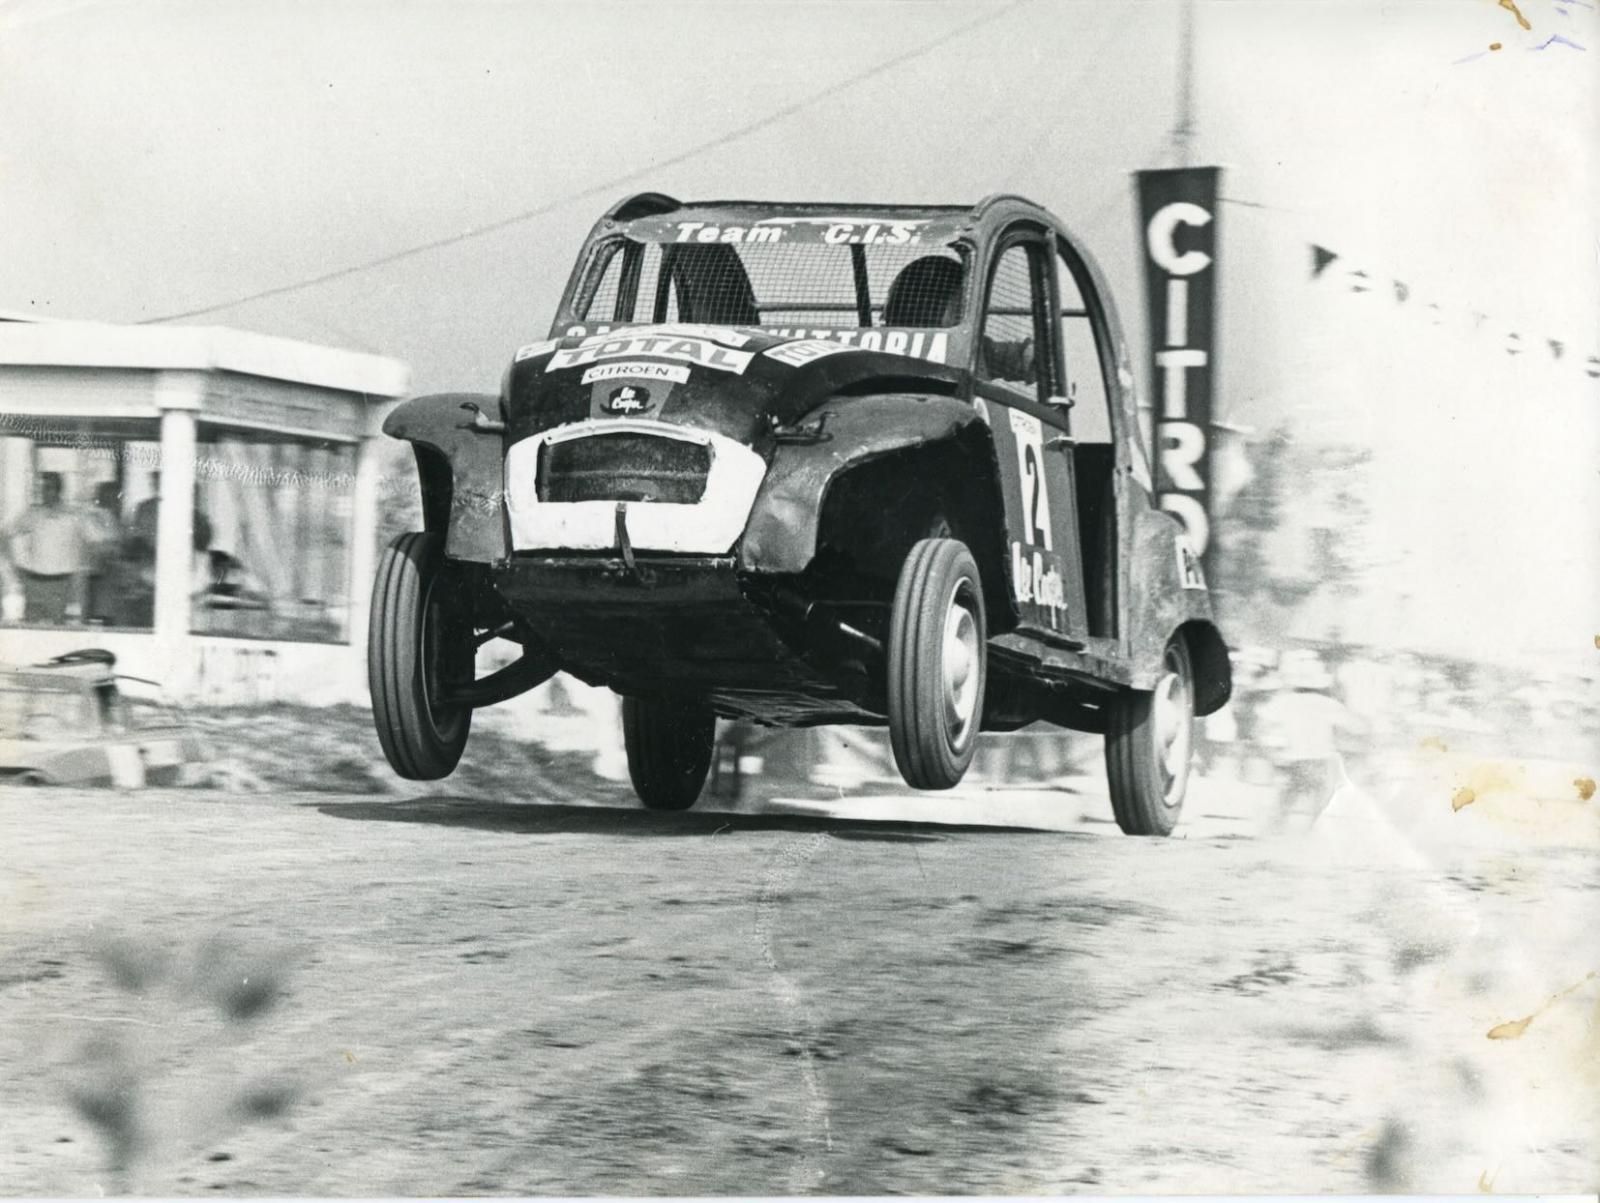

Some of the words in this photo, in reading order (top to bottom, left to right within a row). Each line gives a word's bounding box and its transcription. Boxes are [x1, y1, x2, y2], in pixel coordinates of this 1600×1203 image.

[675, 221, 783, 243] Team
[823, 221, 921, 244] C.I.S.
[560, 336, 740, 368] TOTAL
[1024, 442, 1047, 549] 2
